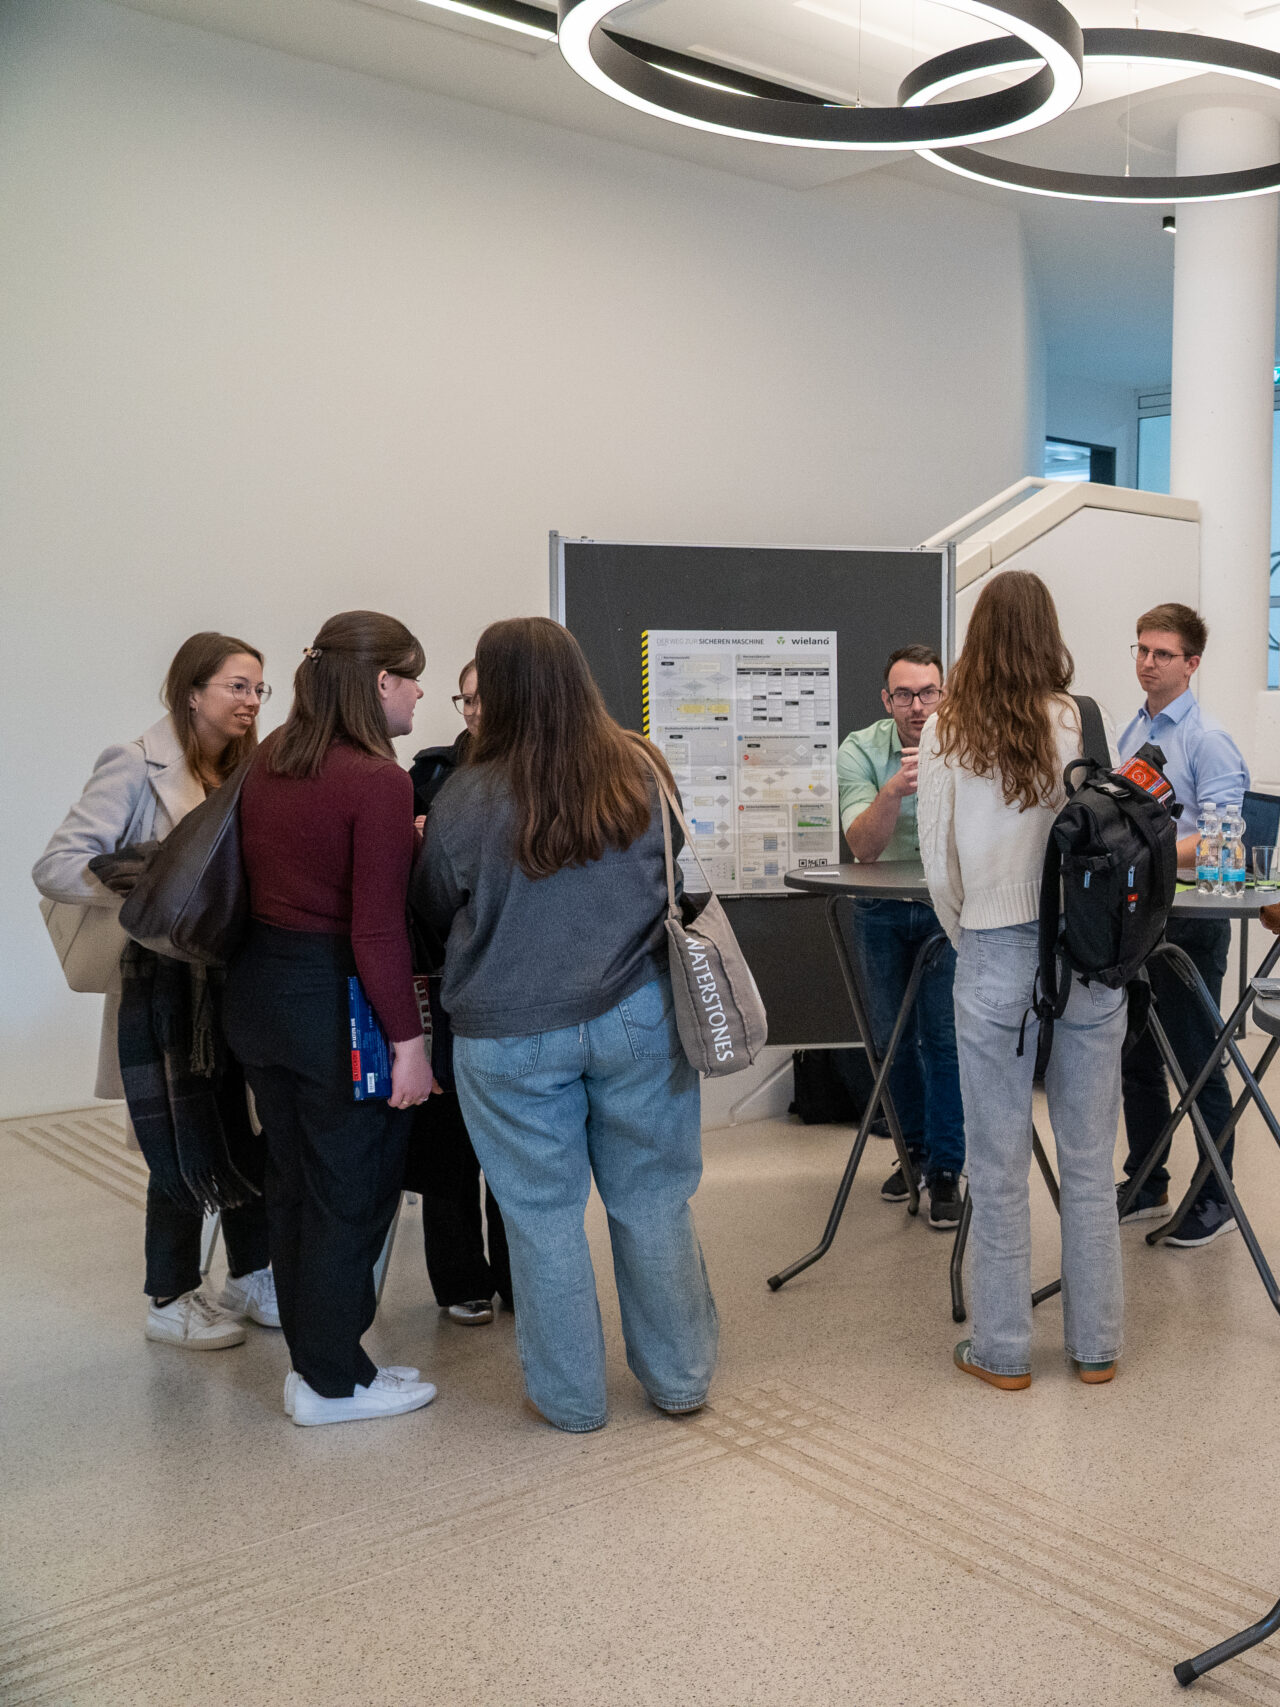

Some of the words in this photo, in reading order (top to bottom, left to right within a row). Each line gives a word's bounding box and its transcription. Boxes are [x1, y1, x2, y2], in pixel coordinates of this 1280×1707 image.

[698, 637, 731, 646] SICHEREN
[731, 637, 765, 646] MASCHINE
[791, 636, 830, 646] wieland
[685, 937, 735, 1063] WATERSTONES
